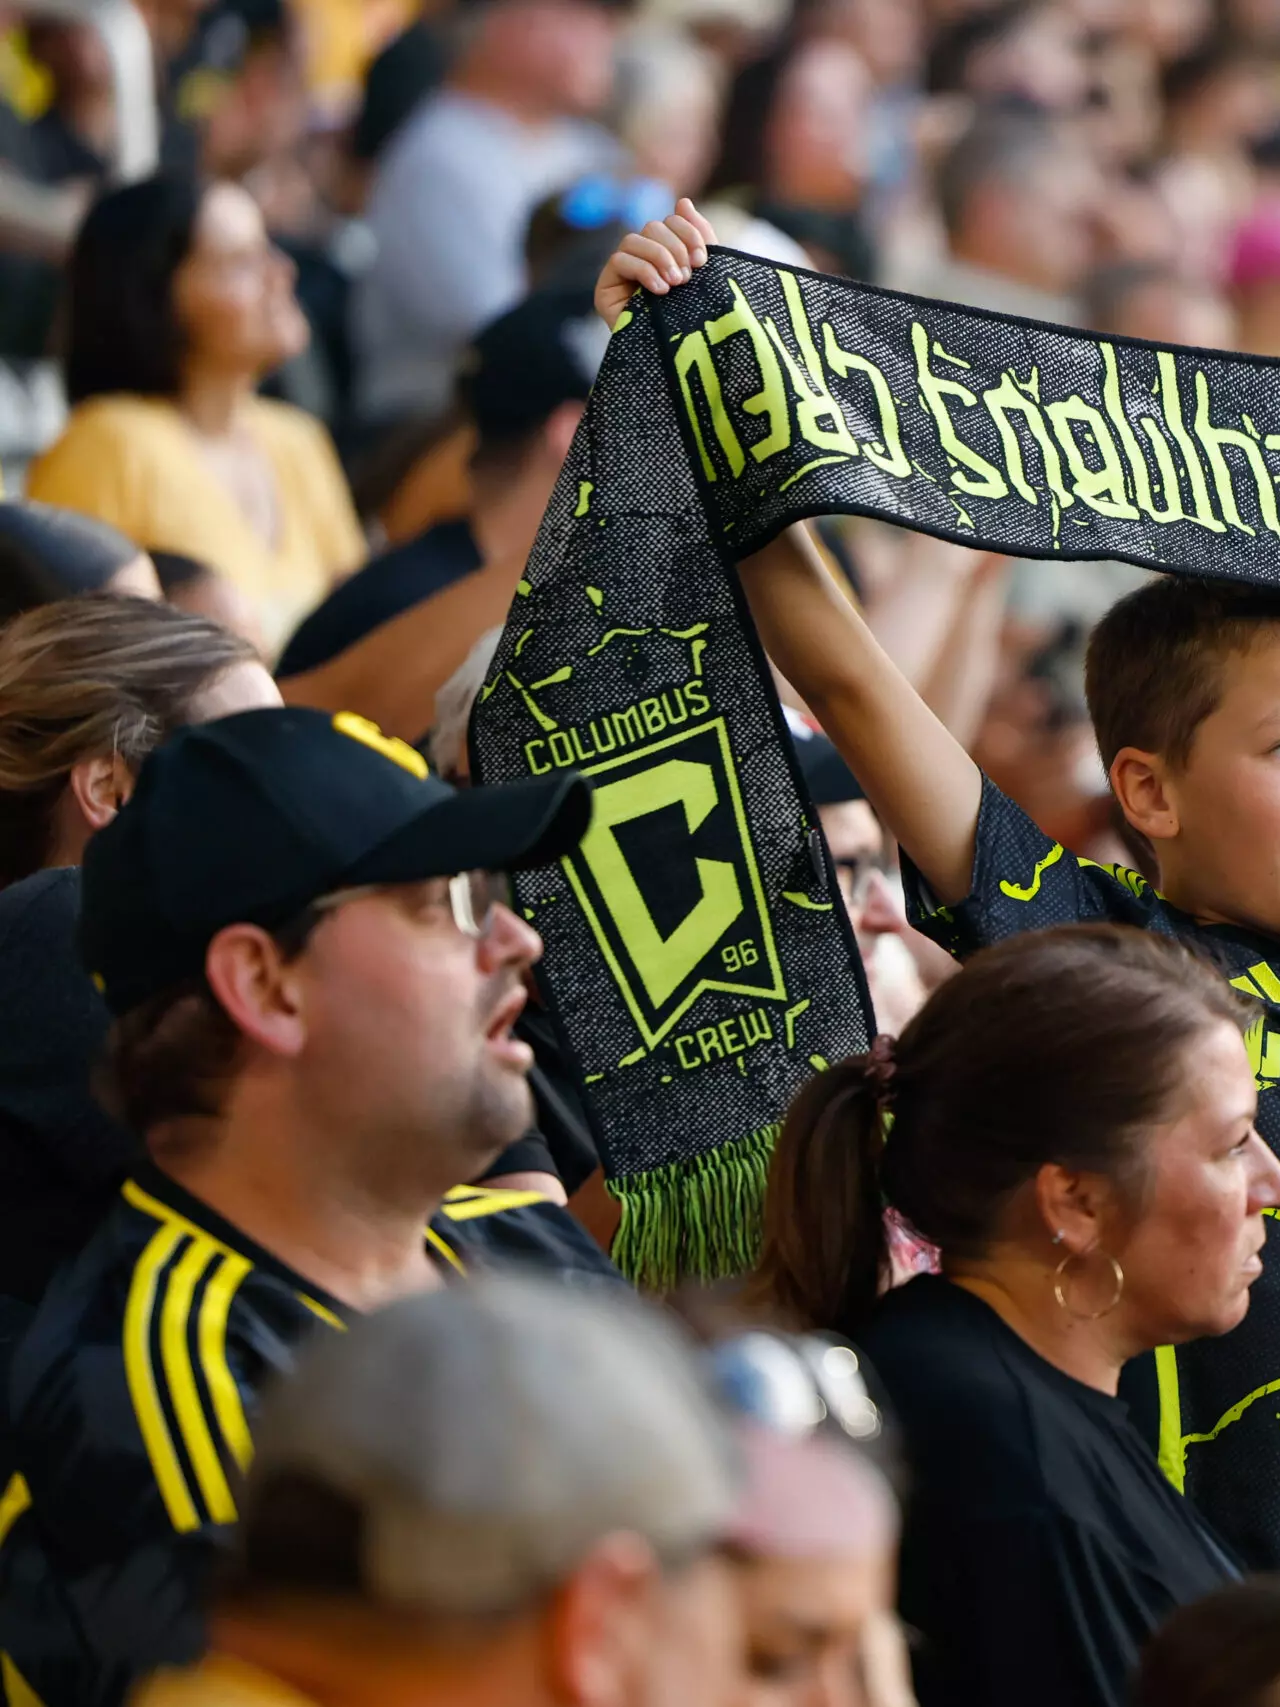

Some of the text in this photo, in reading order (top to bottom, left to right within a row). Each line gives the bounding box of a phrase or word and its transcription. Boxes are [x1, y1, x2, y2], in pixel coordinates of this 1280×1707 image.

[524, 681, 711, 775] COLUMBUS
[721, 939, 759, 973] 96
[674, 1008, 773, 1070] CREW
